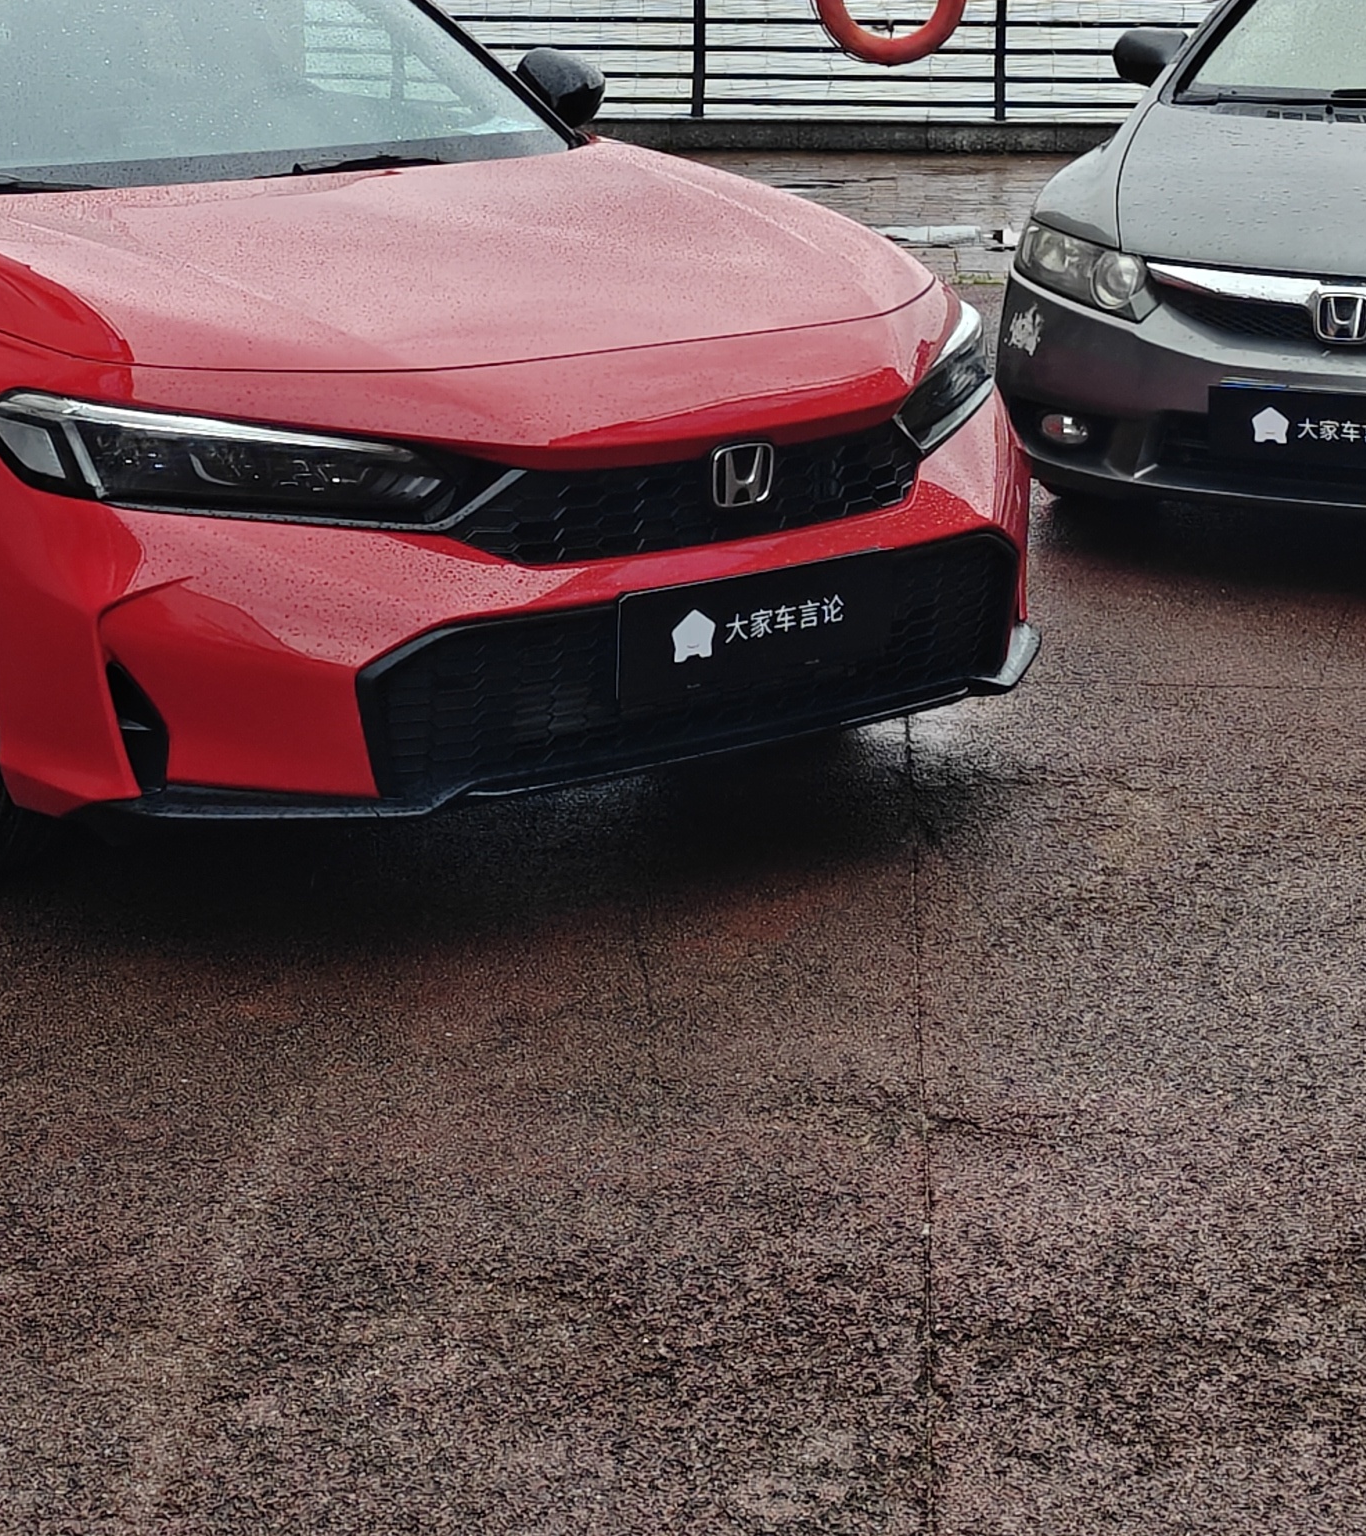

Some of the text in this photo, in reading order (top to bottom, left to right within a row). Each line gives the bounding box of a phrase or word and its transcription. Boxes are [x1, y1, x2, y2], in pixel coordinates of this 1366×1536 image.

[725, 594, 844, 643] 大家车言论
